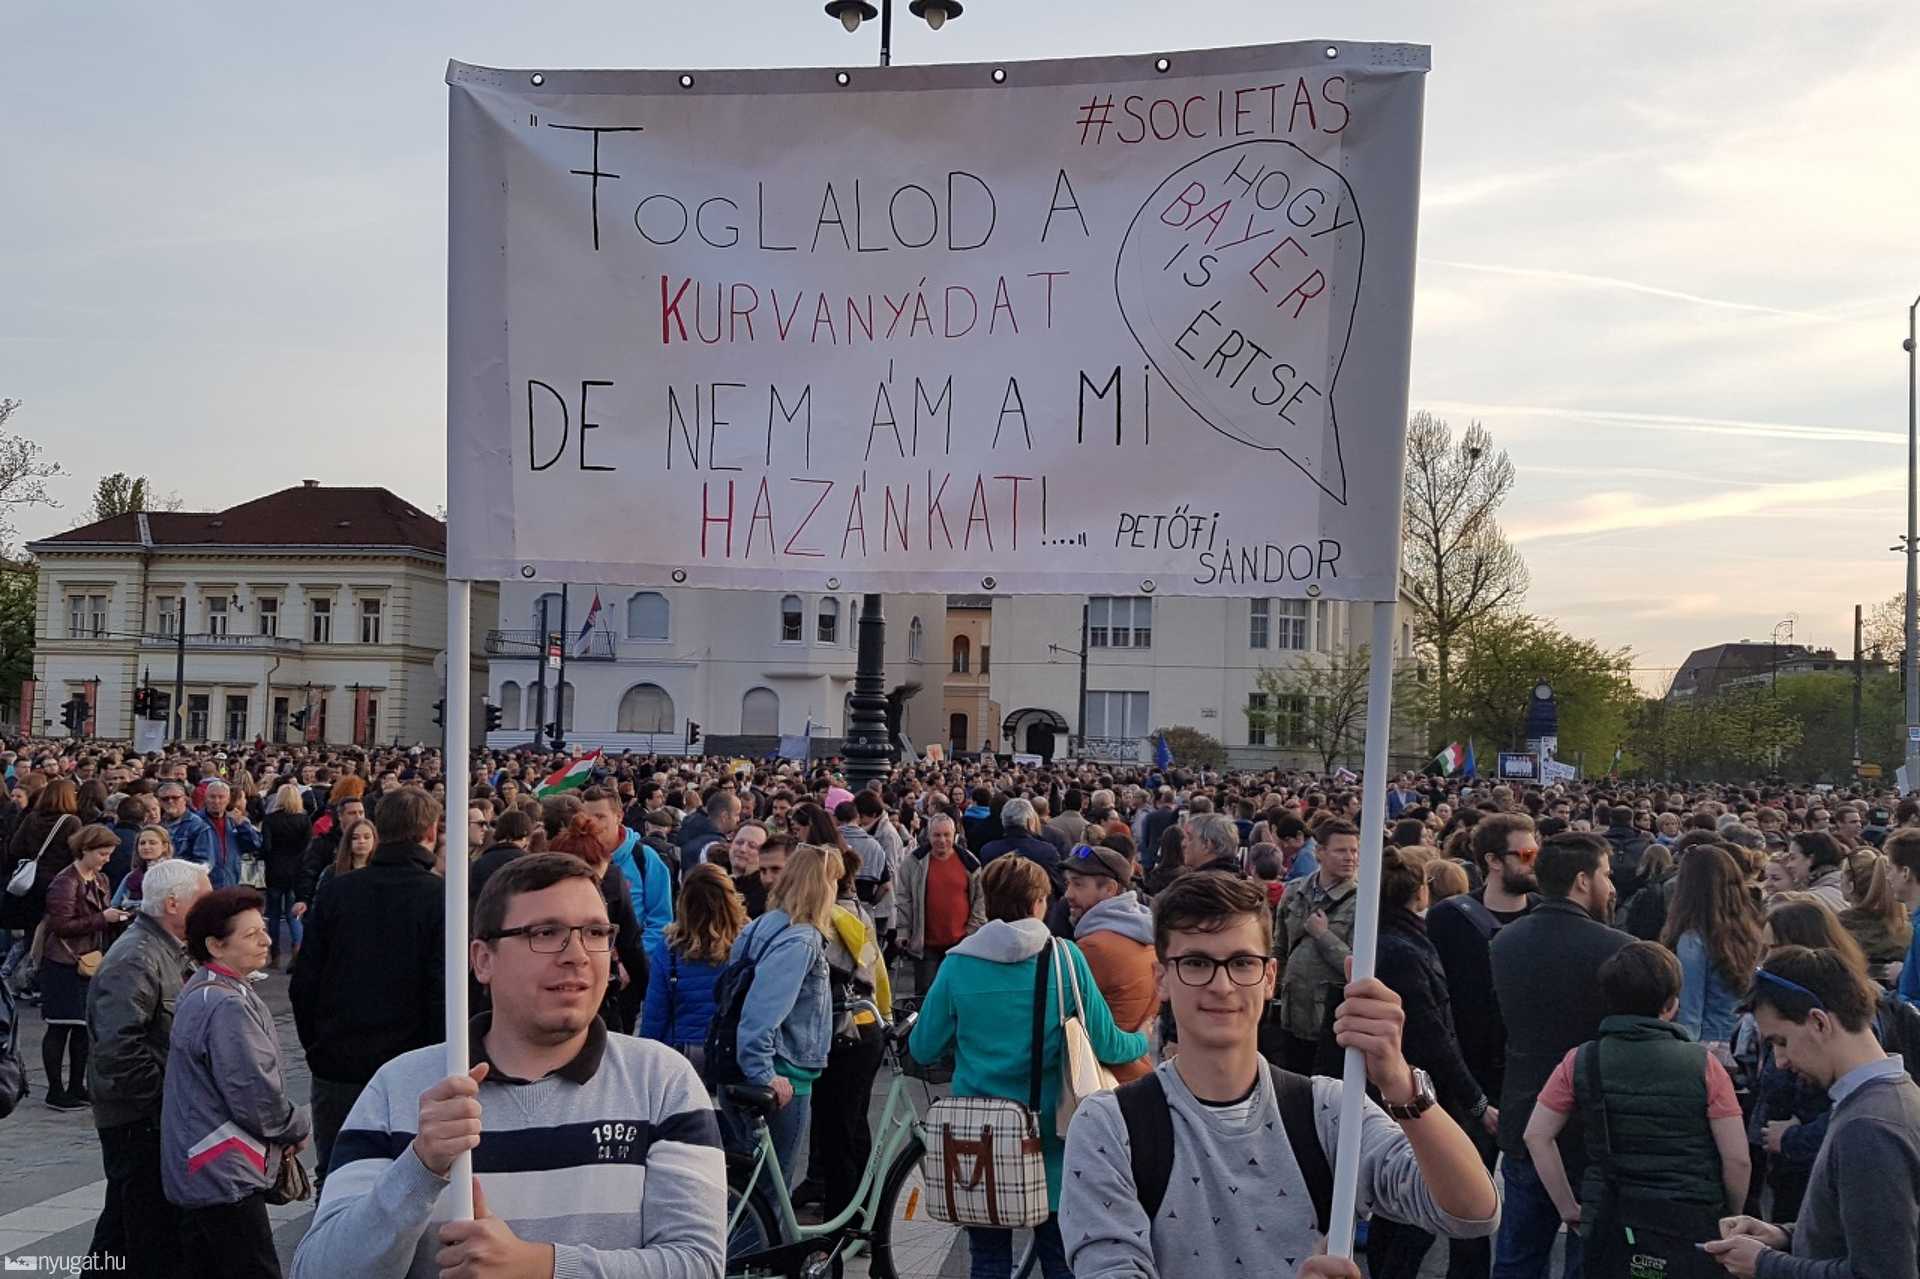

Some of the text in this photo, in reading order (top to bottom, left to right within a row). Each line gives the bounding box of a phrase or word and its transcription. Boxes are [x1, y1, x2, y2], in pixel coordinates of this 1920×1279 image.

[1075, 76, 1351, 146] #SOCIETAS
[1040, 168, 1090, 243] A
[1222, 154, 1355, 238] HOGY
[1159, 181, 1326, 319] BAYER
[1163, 243, 1219, 288] IS
[660, 271, 1070, 346] KURVANYÁDAT
[1173, 300, 1322, 426] ÉRTSE
[527, 379, 617, 472] DE
[666, 382, 813, 471] NEM
[864, 357, 953, 462] ÁM
[991, 375, 1032, 451] A
[1192, 538, 1342, 585] SÁNDOR
